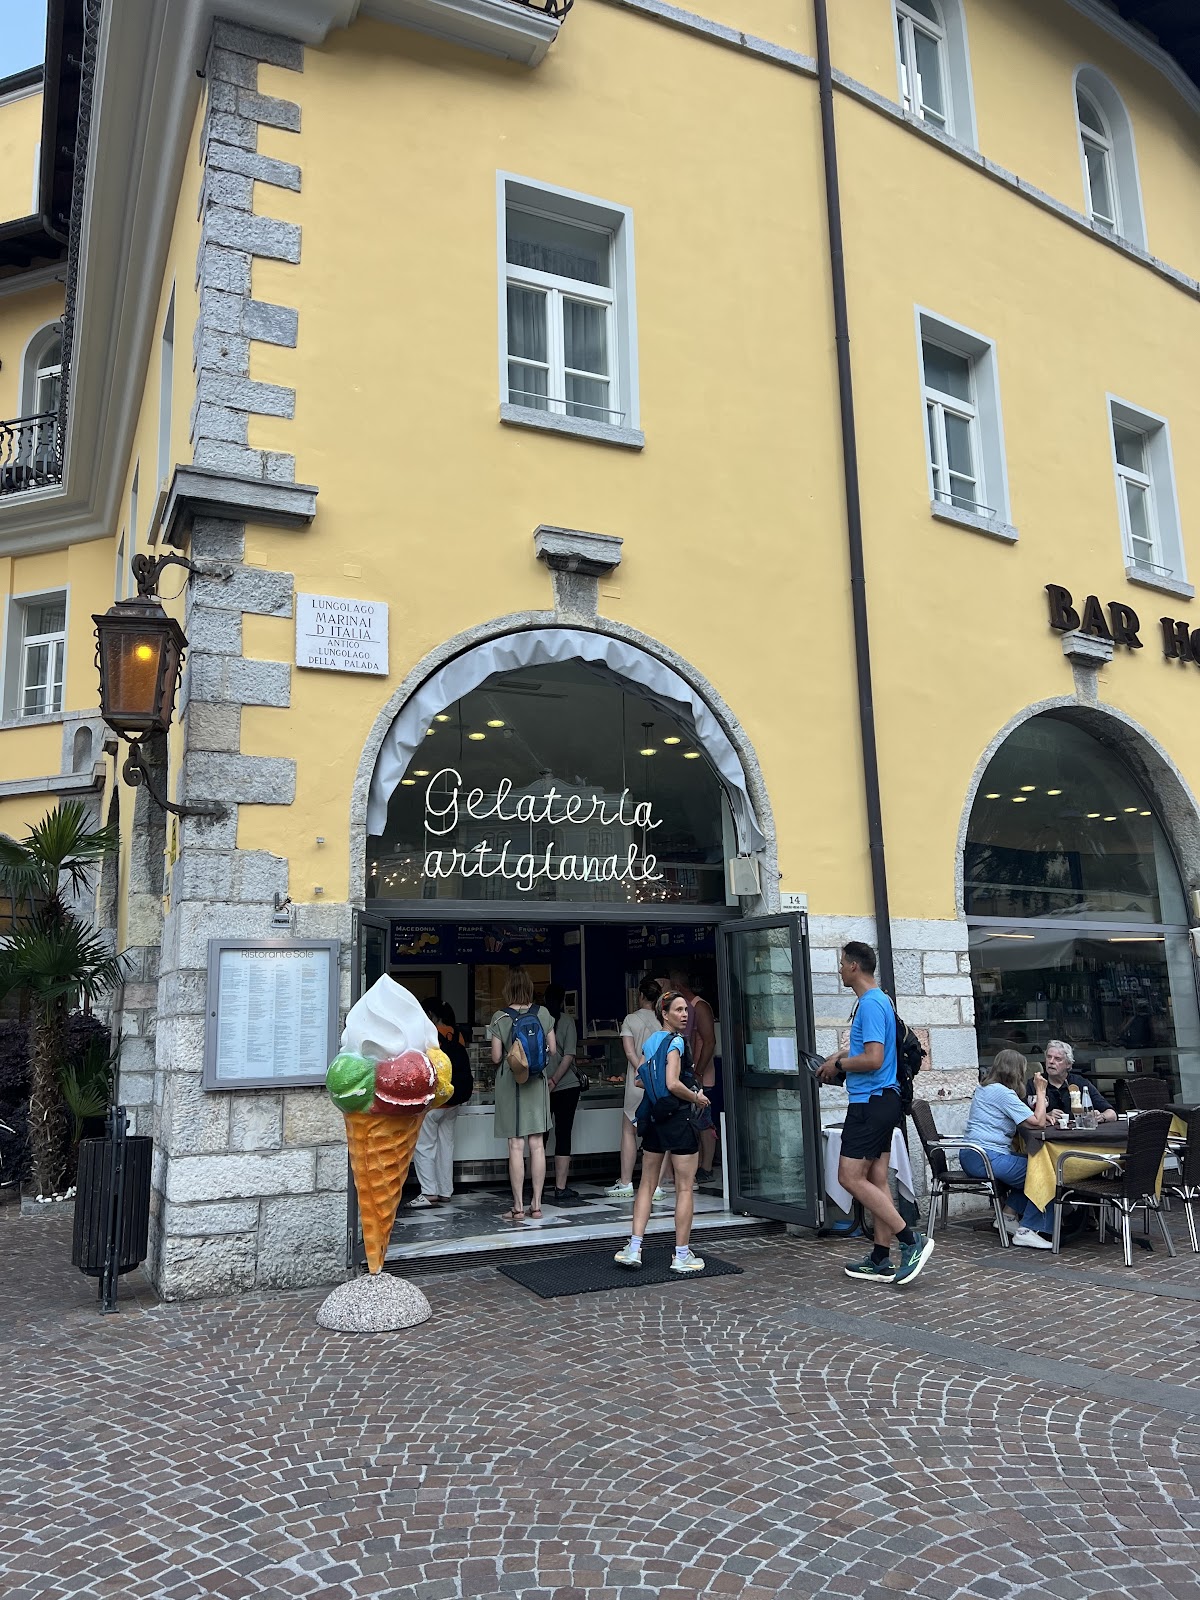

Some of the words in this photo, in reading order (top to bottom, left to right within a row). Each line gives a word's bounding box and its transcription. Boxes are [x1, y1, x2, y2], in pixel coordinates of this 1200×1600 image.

[311, 599, 375, 615] LUNGOLAGO
[315, 612, 372, 628] MARINAI
[1044, 583, 1144, 649] BAR
[1159, 616, 1200, 668] H
[327, 639, 360, 649] ANTICO
[318, 647, 370, 659] LUNGOLAGO
[308, 656, 336, 666] DELLA
[344, 659, 379, 670] PALADA
[424, 768, 663, 835] Gelateria
[424, 840, 664, 891] artigianale
[789, 896, 801, 904] 14
[241, 949, 293, 959] Ristorante
[293, 949, 314, 959] Sole
